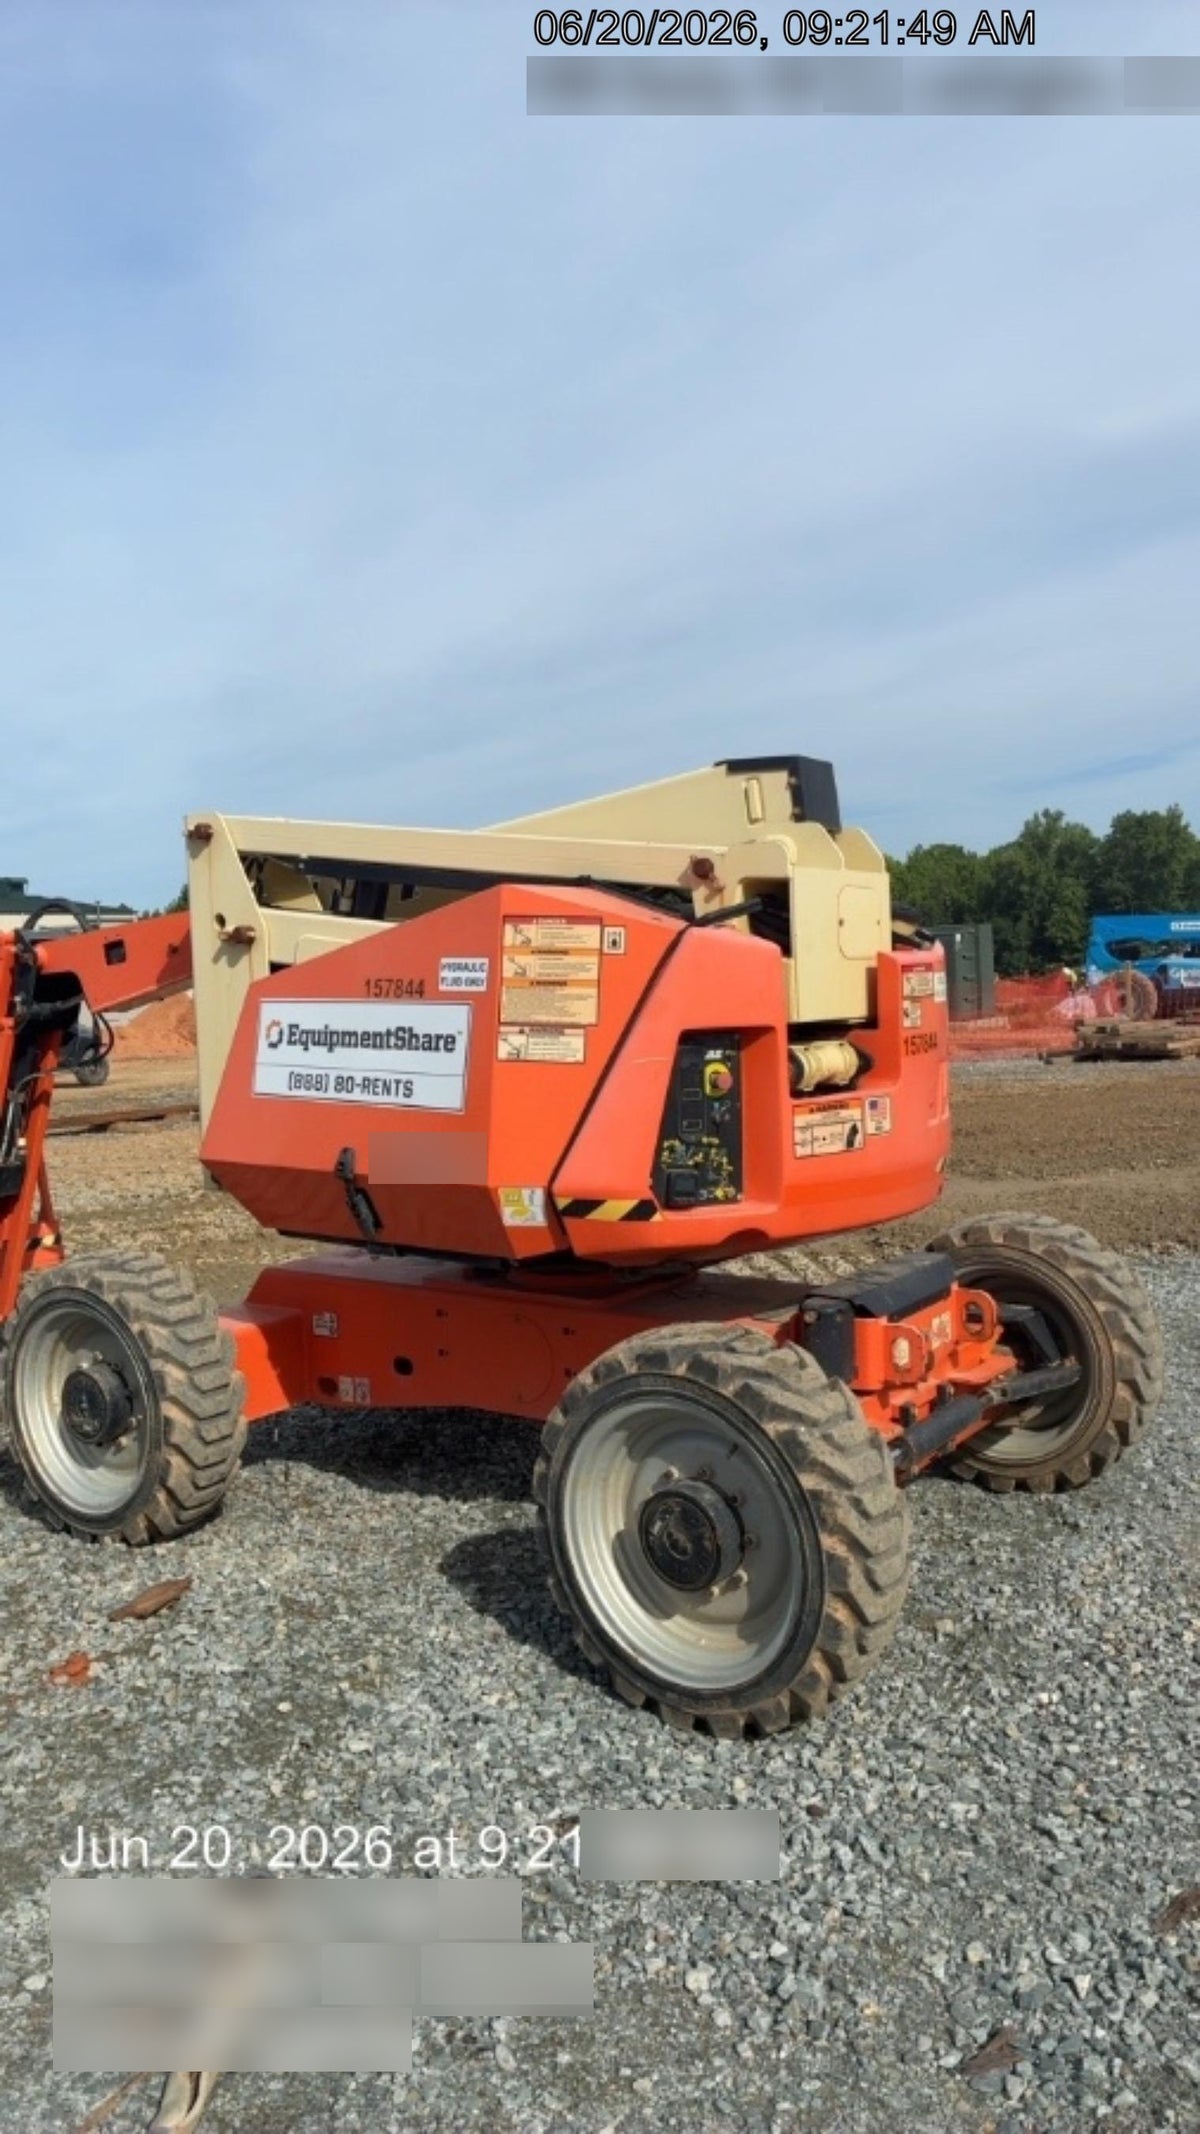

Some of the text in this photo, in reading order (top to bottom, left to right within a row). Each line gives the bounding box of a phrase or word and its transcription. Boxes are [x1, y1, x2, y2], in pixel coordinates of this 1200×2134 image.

[364, 977, 425, 999] 157844
[286, 1024, 457, 1054] EquipmentShare
[288, 1070, 414, 1099] (888) 80-RENTS
